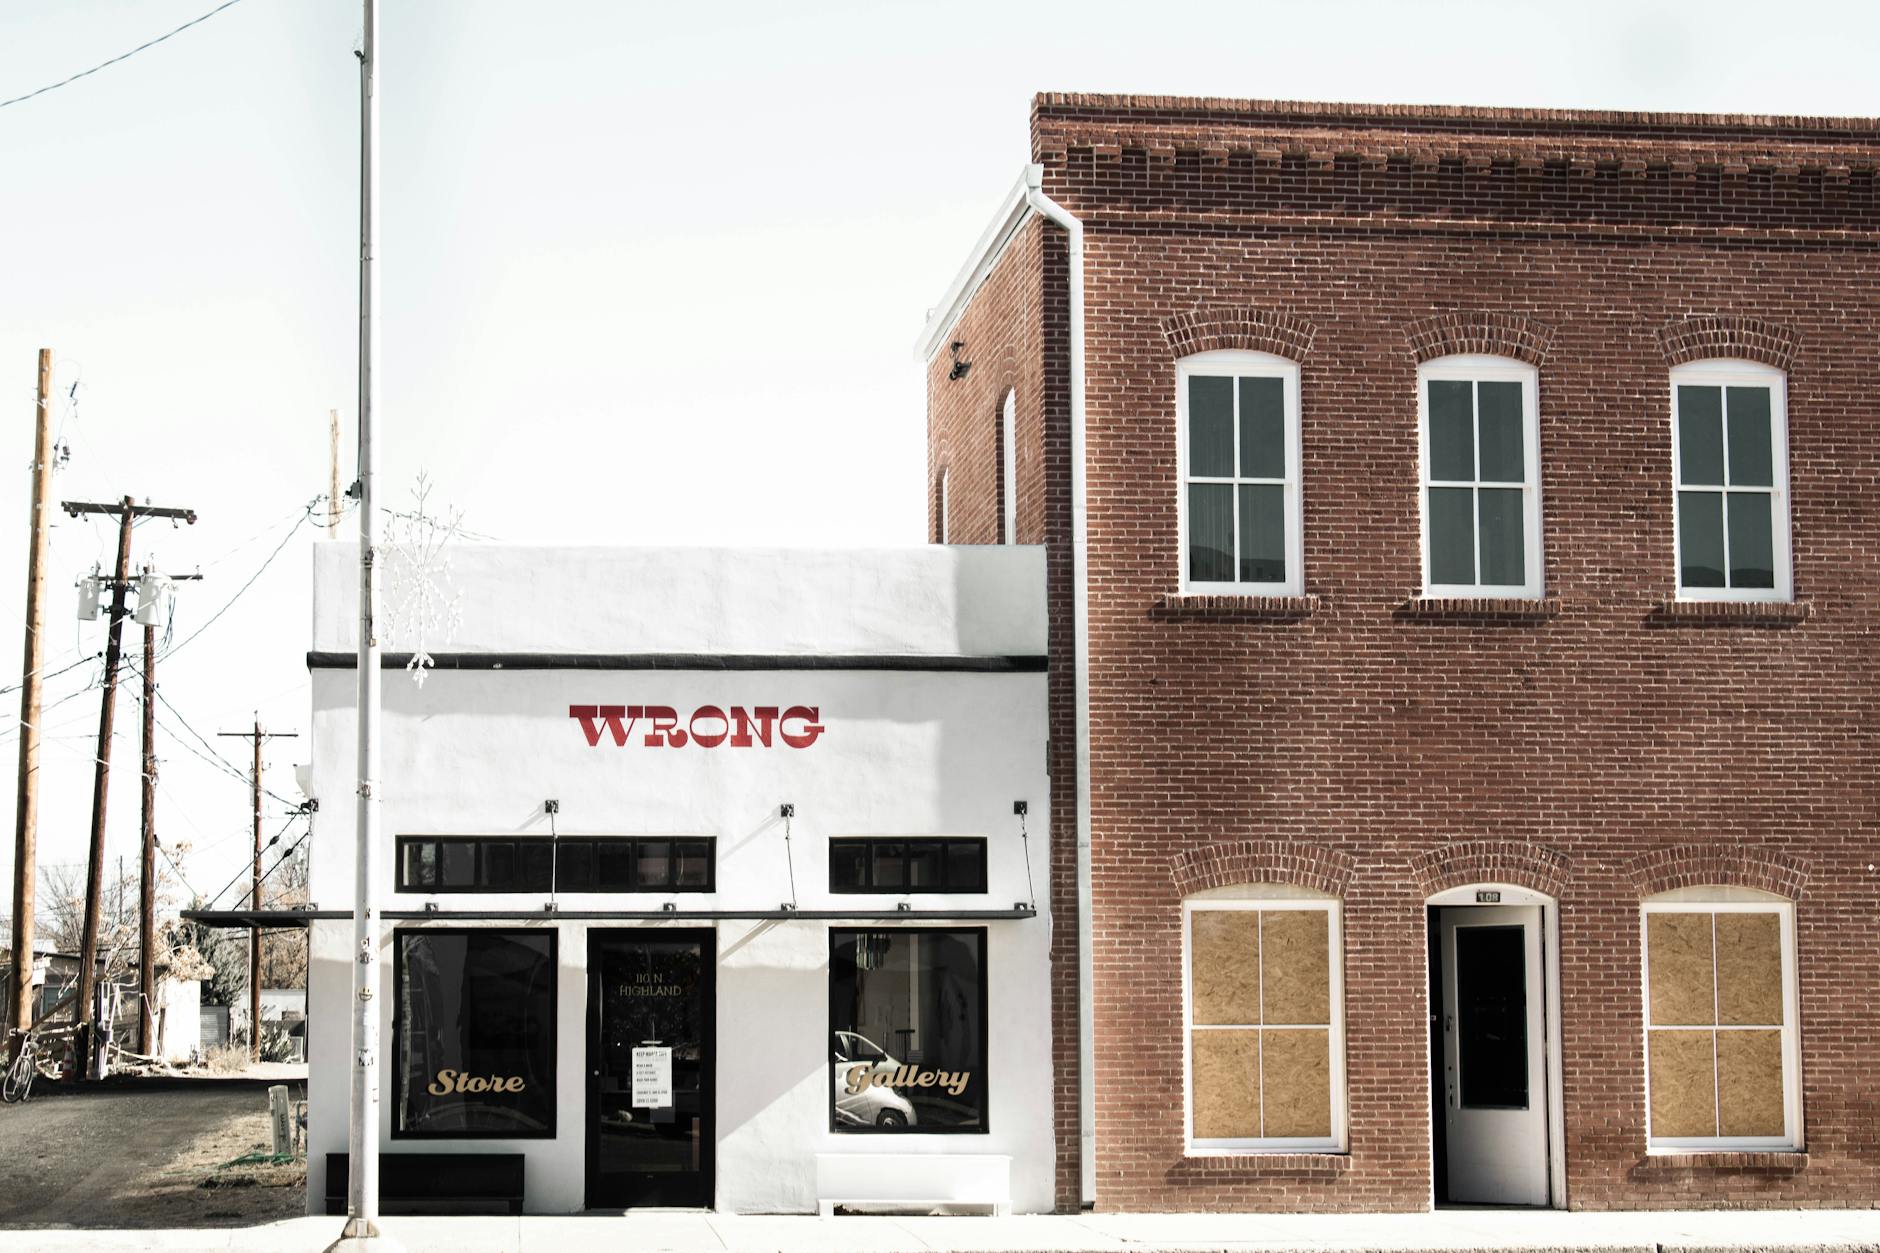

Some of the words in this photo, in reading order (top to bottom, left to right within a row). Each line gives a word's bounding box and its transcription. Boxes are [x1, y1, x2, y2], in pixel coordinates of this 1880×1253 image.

[569, 705, 825, 749] WRONG
[620, 985, 682, 997] HIGHLAND
[654, 973, 663, 984] N
[428, 1069, 525, 1096] Store
[845, 1064, 970, 1096] Gallery
